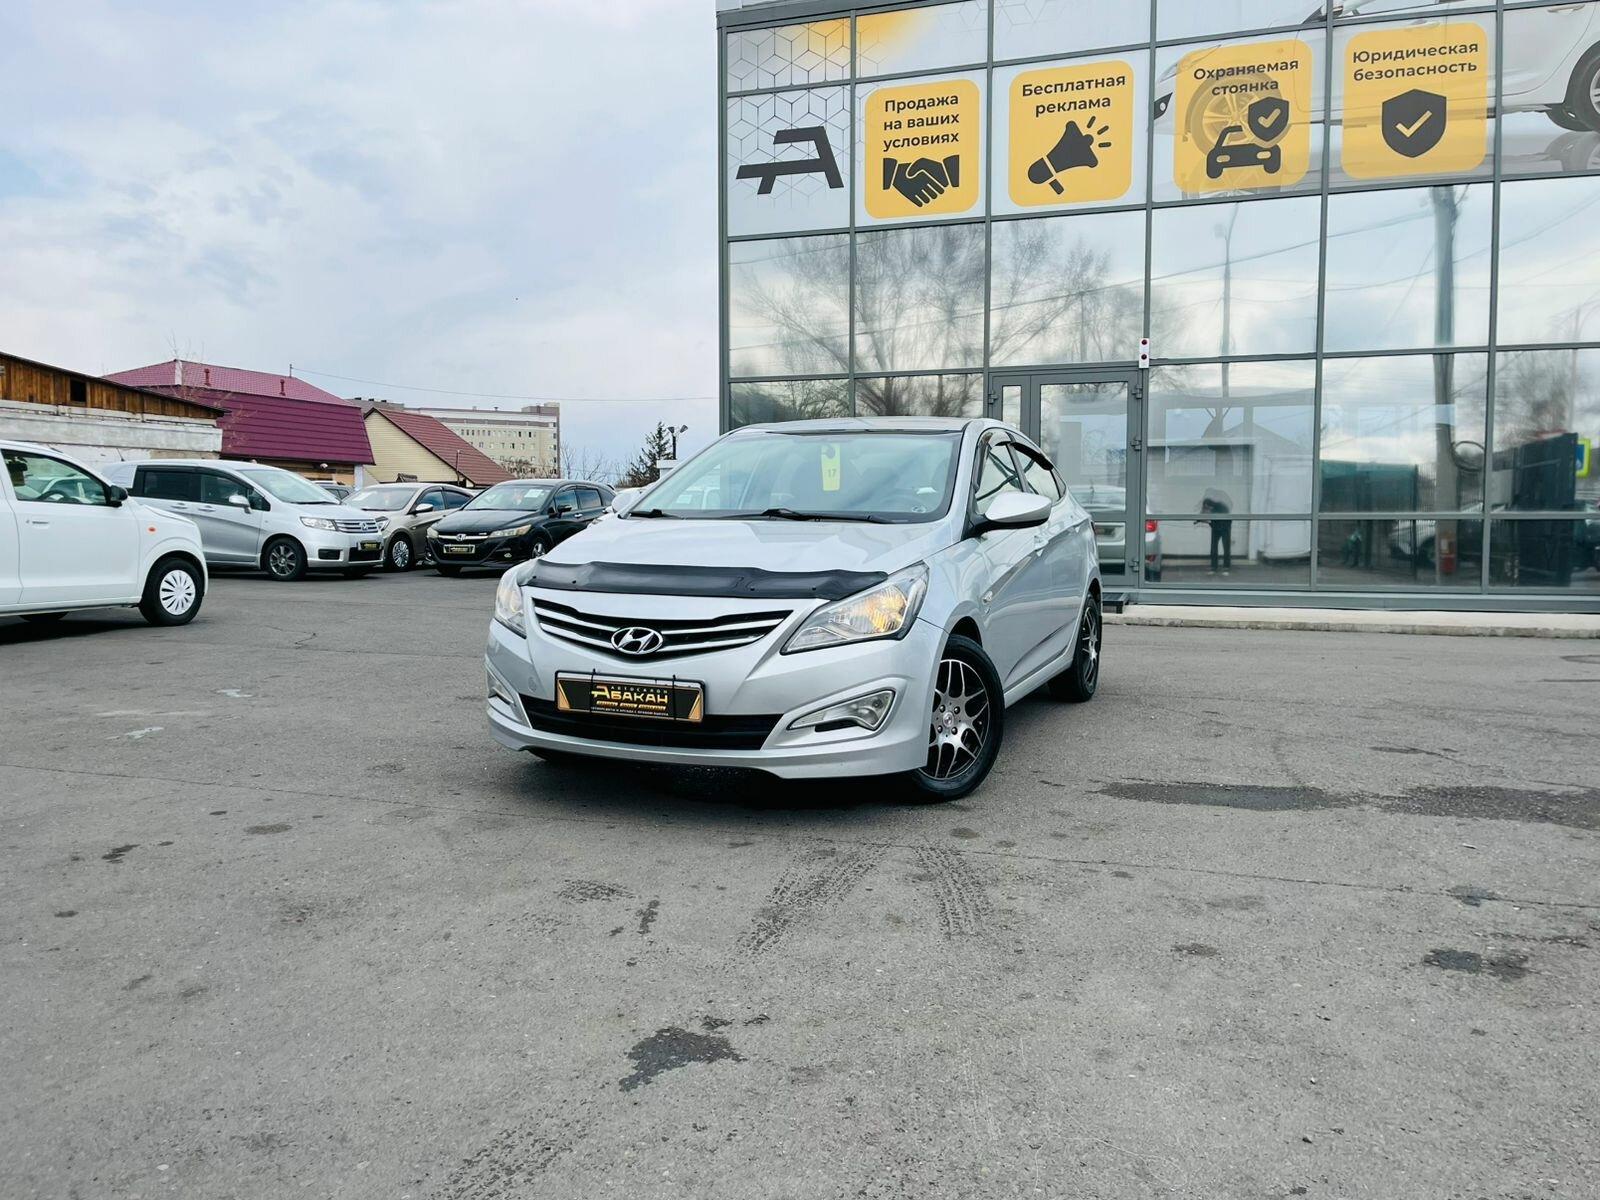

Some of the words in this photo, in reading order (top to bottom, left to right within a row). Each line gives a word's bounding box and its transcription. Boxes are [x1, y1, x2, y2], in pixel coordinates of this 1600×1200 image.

[1353, 43, 1478, 64] Юридическая
[1193, 60, 1299, 80] Охраняемая
[1353, 62, 1477, 81] безопасность
[1022, 75, 1126, 97] Бесплатная
[1211, 80, 1279, 96] стоянка
[884, 95, 959, 114] Продажа
[1035, 97, 1111, 118] реклама
[883, 120, 902, 131] на
[907, 113, 960, 129] ваших
[883, 132, 959, 152] условиях
